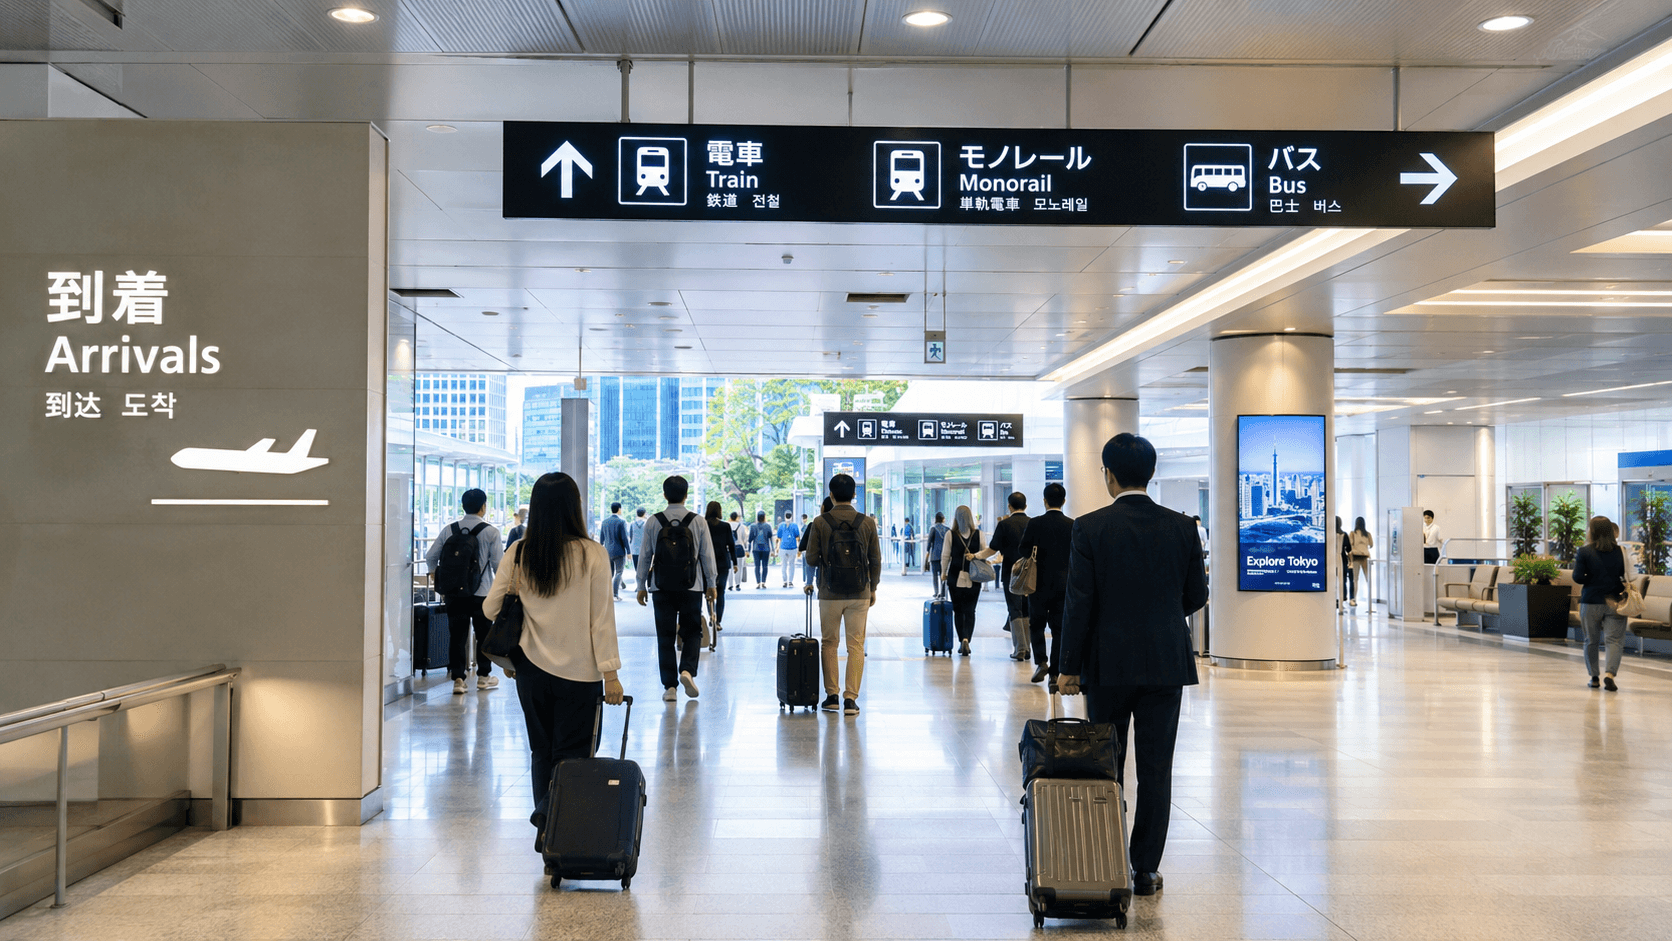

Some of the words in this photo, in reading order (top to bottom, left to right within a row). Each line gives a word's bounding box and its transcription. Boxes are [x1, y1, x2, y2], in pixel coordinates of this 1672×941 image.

[707, 140, 763, 167] 電車
[960, 145, 1092, 170] モノレール
[1268, 145, 1322, 171] バス
[706, 170, 758, 188] Train
[960, 173, 1051, 192] Monorail
[1269, 176, 1307, 194] Bus
[706, 193, 738, 208] 鉄道
[752, 194, 780, 208] 전철
[1033, 197, 1088, 212] 모노레일
[1270, 199, 1300, 213] 巴士
[1313, 199, 1342, 214] 버스
[46, 270, 169, 325] 到着
[45, 334, 221, 375] Arrivals
[45, 392, 102, 419] 到达
[121, 392, 177, 420] 도착
[1246, 556, 1286, 568] Explore
[1287, 556, 1319, 568] Tokyo
